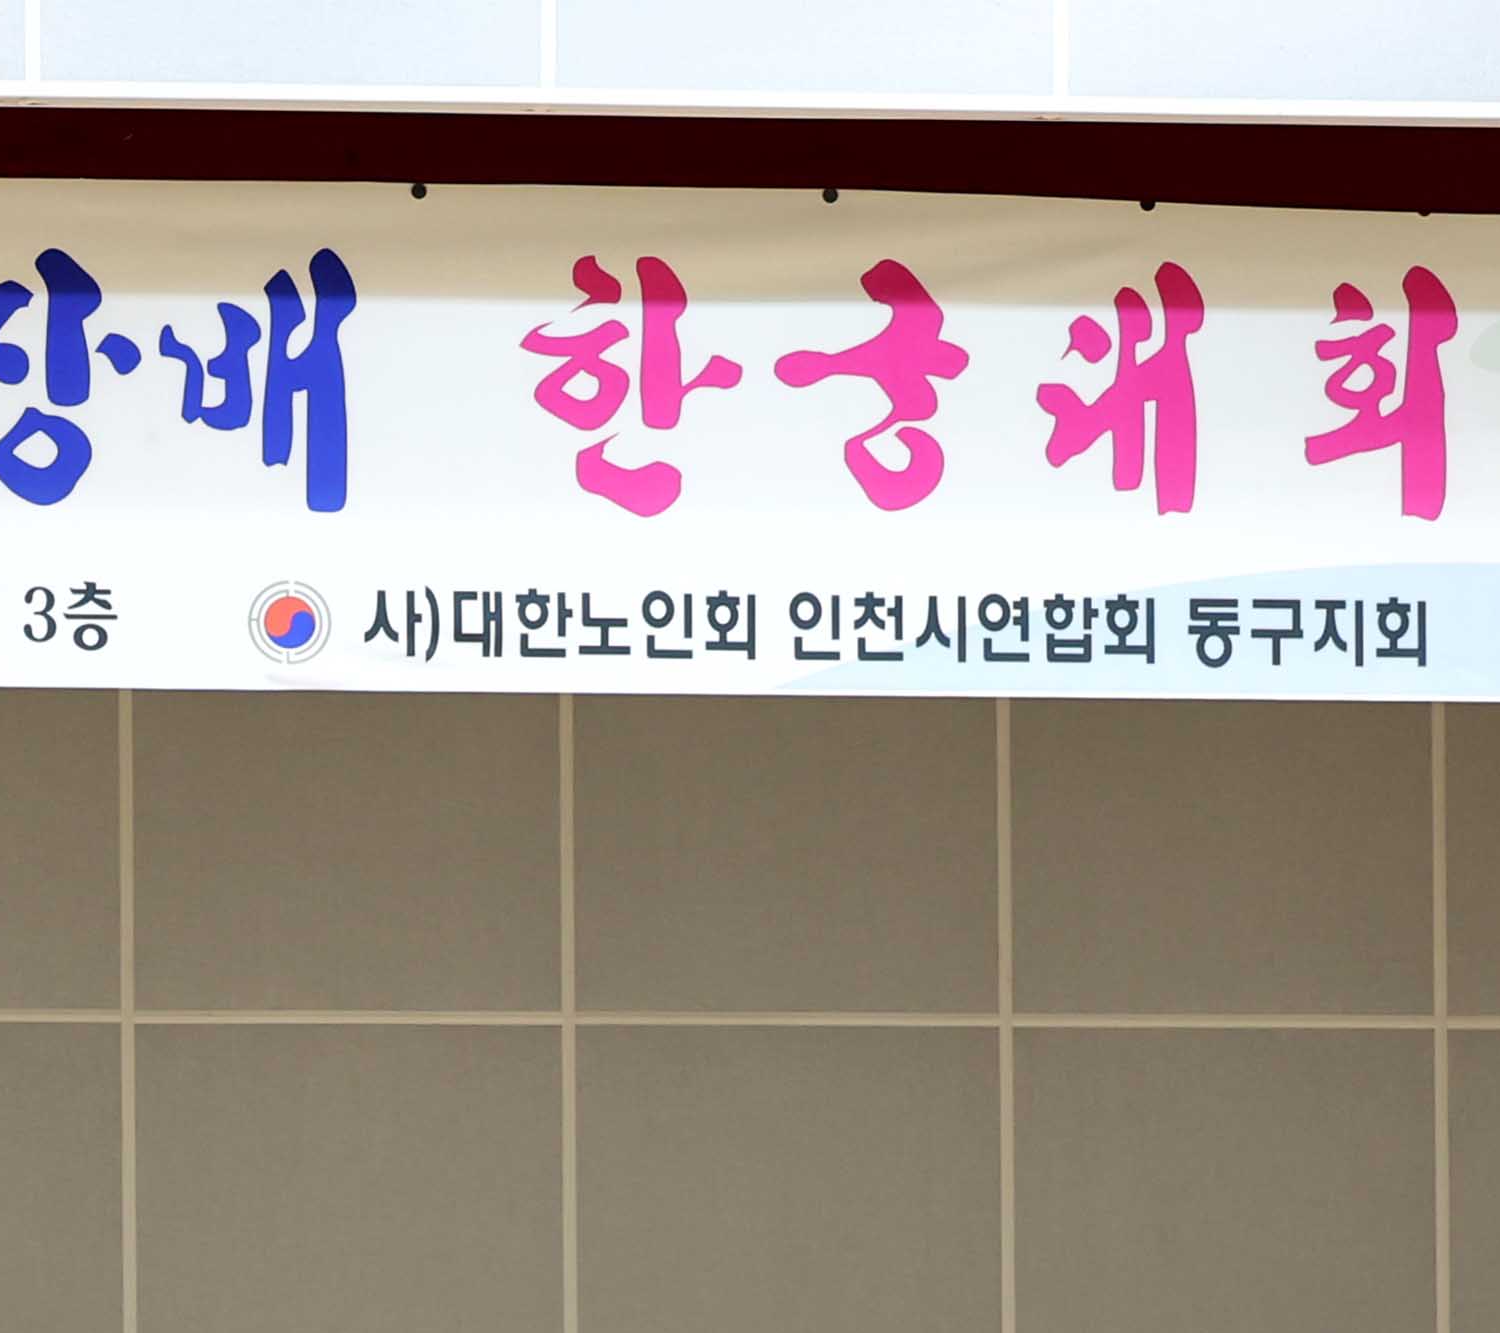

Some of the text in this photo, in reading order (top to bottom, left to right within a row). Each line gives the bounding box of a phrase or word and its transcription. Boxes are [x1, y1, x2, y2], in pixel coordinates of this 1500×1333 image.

[22, 580, 119, 652] 3층
[363, 585, 1428, 669] 사)대한노인회 인천시연합회 동구지회
